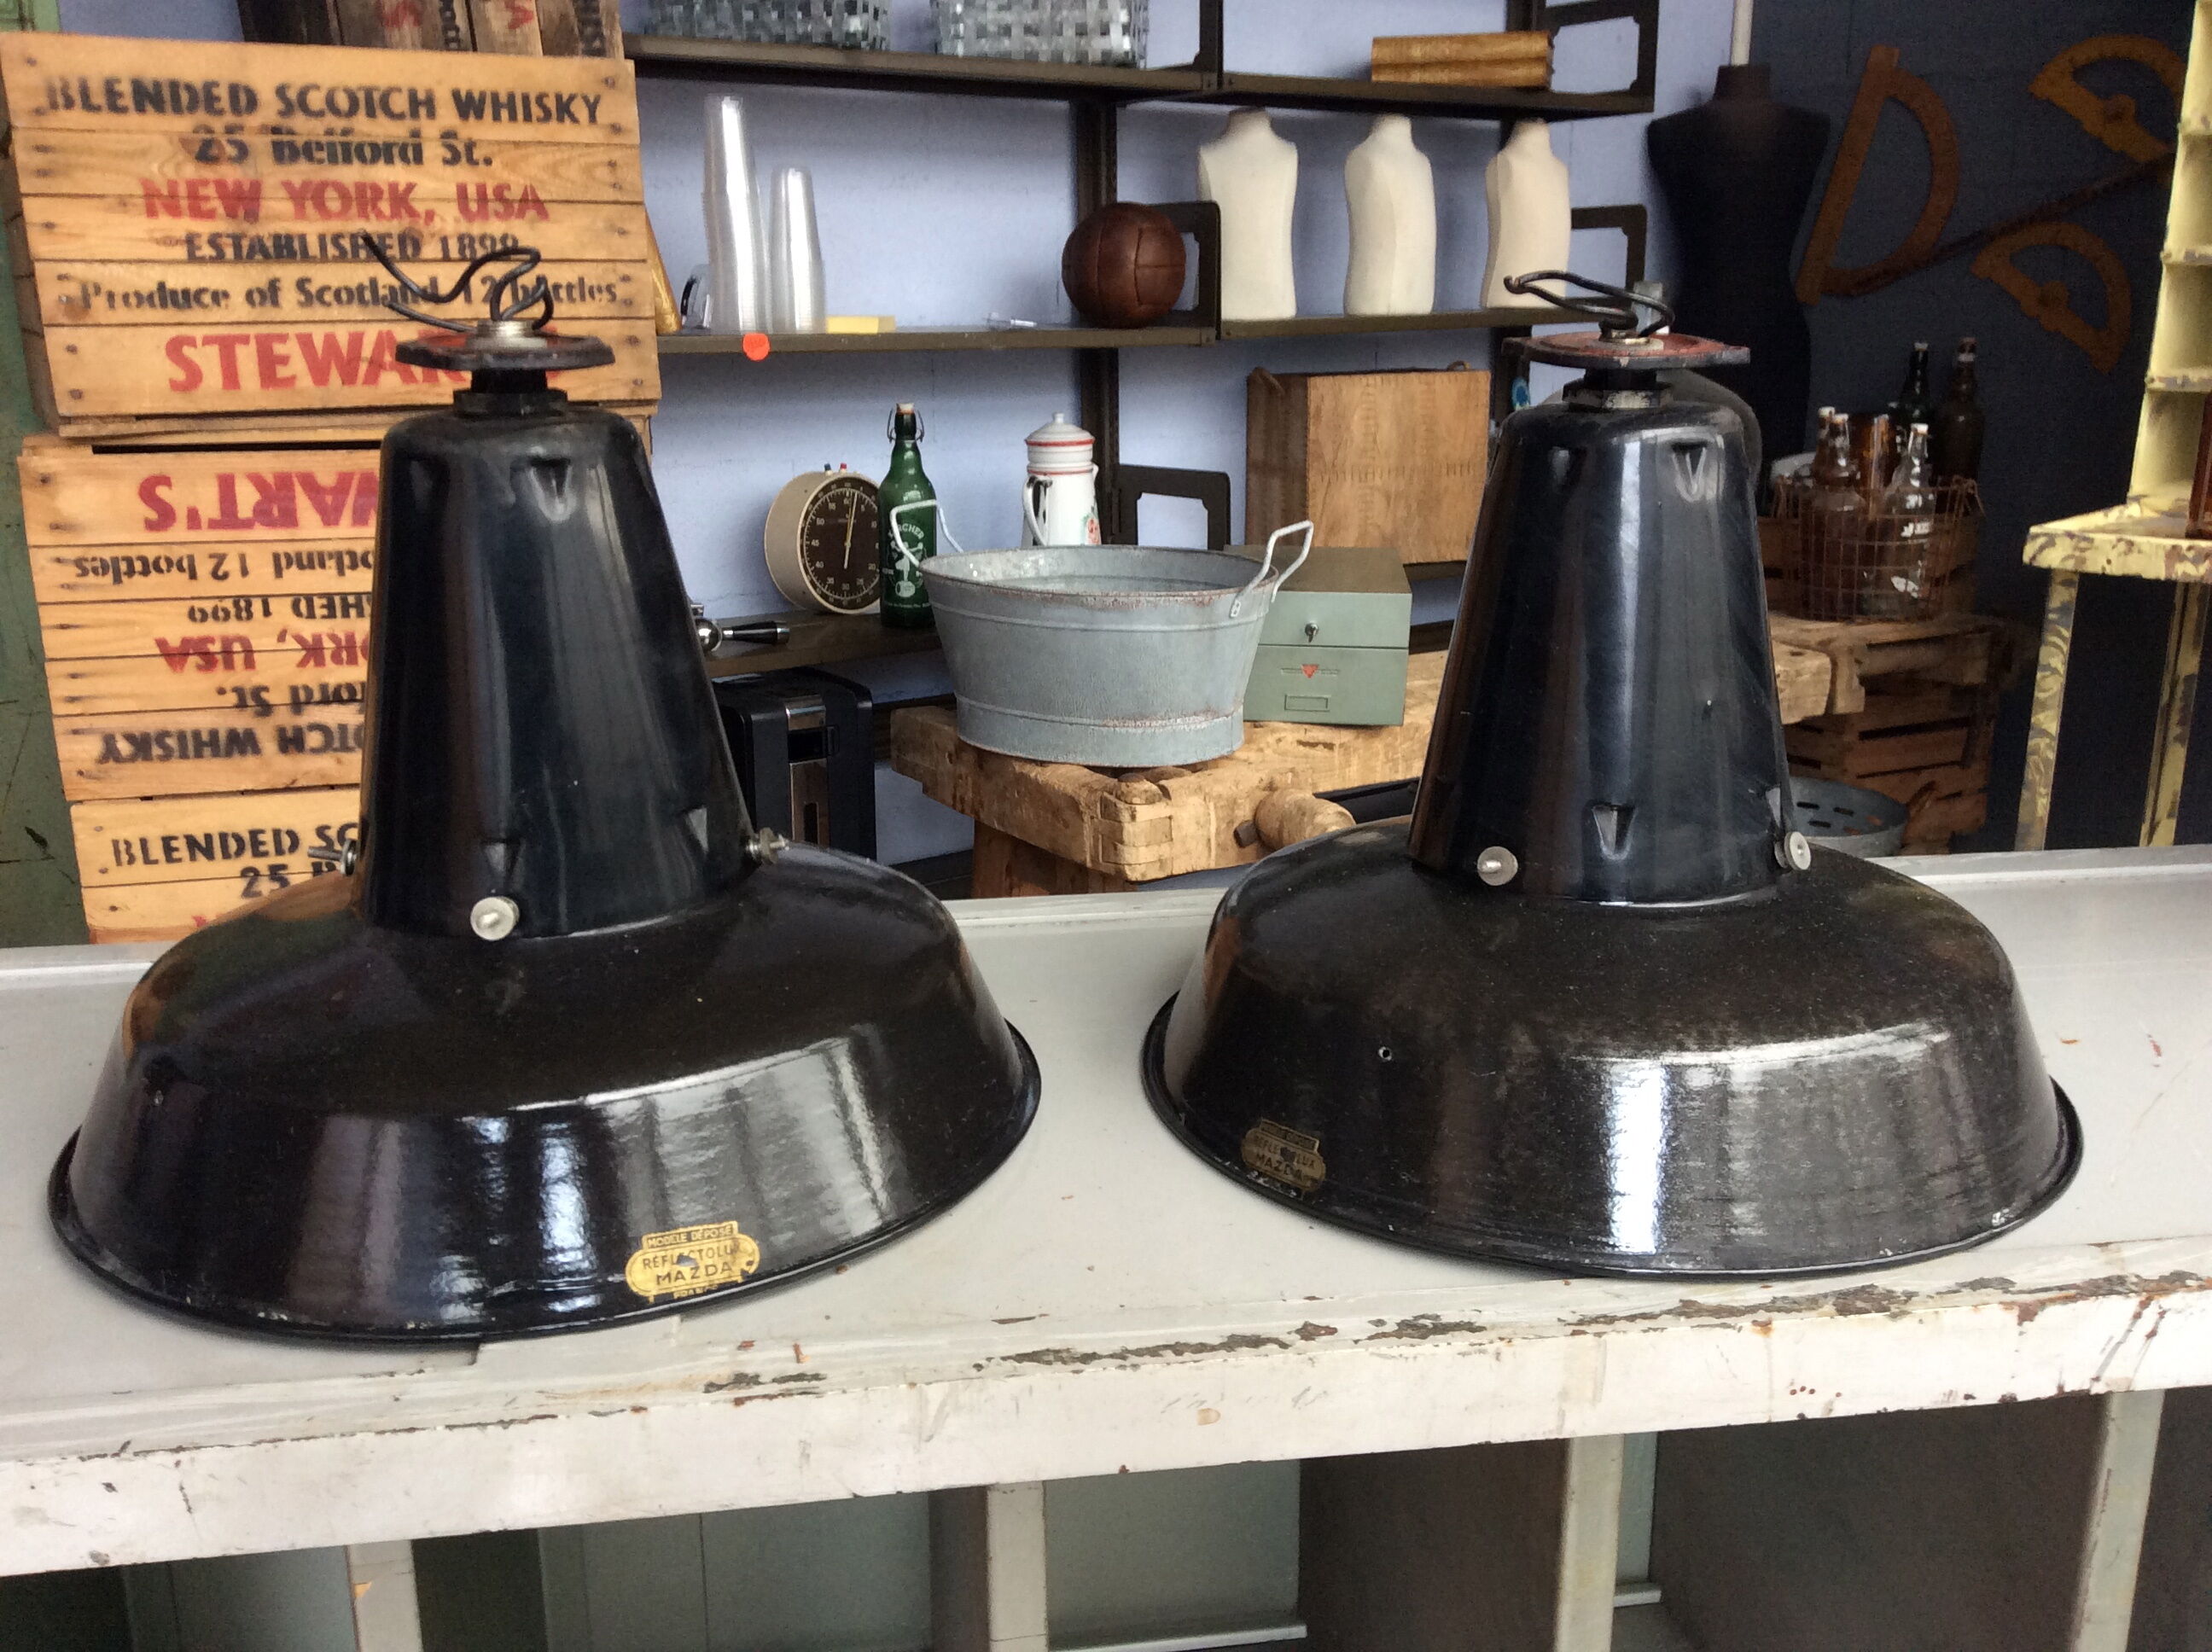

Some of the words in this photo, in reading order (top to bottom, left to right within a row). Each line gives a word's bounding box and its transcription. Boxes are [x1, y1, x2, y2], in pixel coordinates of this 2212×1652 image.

[48, 76, 258, 116] BLENDED
[275, 83, 436, 121] SCOTCH
[451, 87, 601, 125] WHISKY
[192, 124, 249, 165] 25
[439, 129, 493, 166] St.
[139, 177, 263, 221] NEW
[281, 179, 437, 225] YORK,
[455, 181, 550, 223] USA
[184, 230, 422, 260] ESTABLISHED
[79, 280, 230, 310] Produce
[245, 276, 282, 308] of
[509, 275, 617, 305] bttles
[165, 328, 559, 393] STEWA
[138, 471, 380, 532] ART'S
[73, 554, 198, 585] bottles
[207, 553, 250, 581] 12
[272, 550, 374, 579] otland
[188, 596, 273, 623] 1899
[154, 634, 256, 673] USA
[216, 684, 274, 718] St.
[99, 728, 262, 764] WHISKY
[111, 828, 300, 868] BLENDED
[240, 863, 291, 899] 25
[656, 1261, 733, 1285] MAZDA
